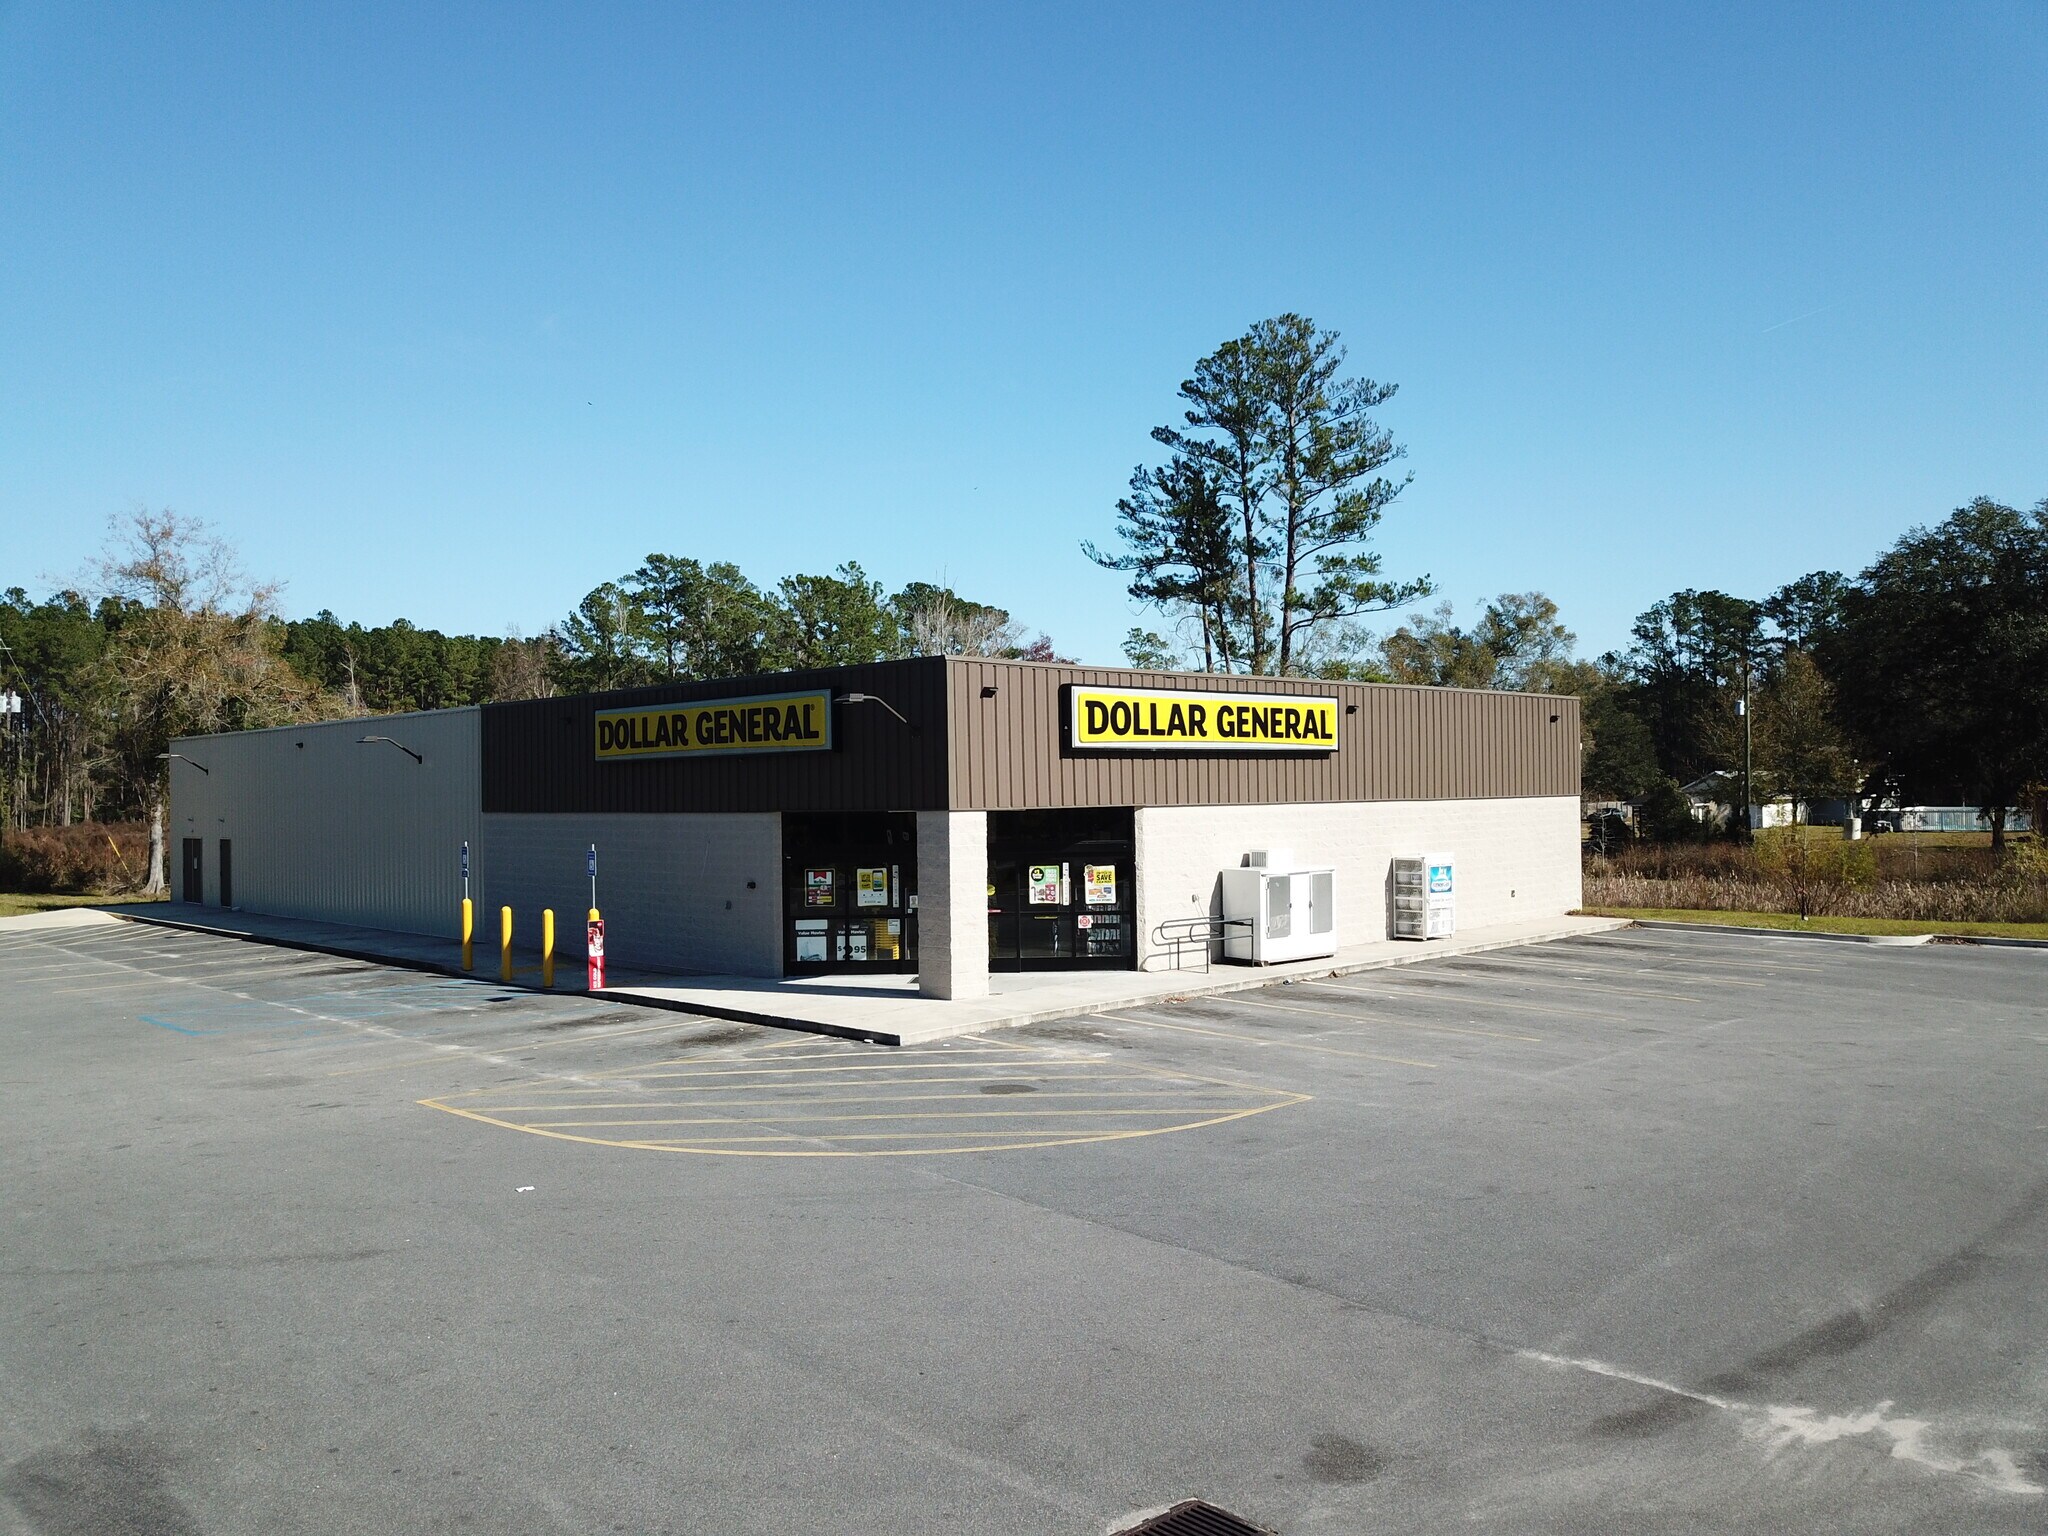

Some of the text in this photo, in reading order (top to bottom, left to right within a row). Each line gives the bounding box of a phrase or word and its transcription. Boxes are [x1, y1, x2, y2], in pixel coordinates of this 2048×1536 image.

[598, 704, 819, 751] DOLLAR GENERAL
[1085, 700, 1333, 740] DOLLAR GENERAL
